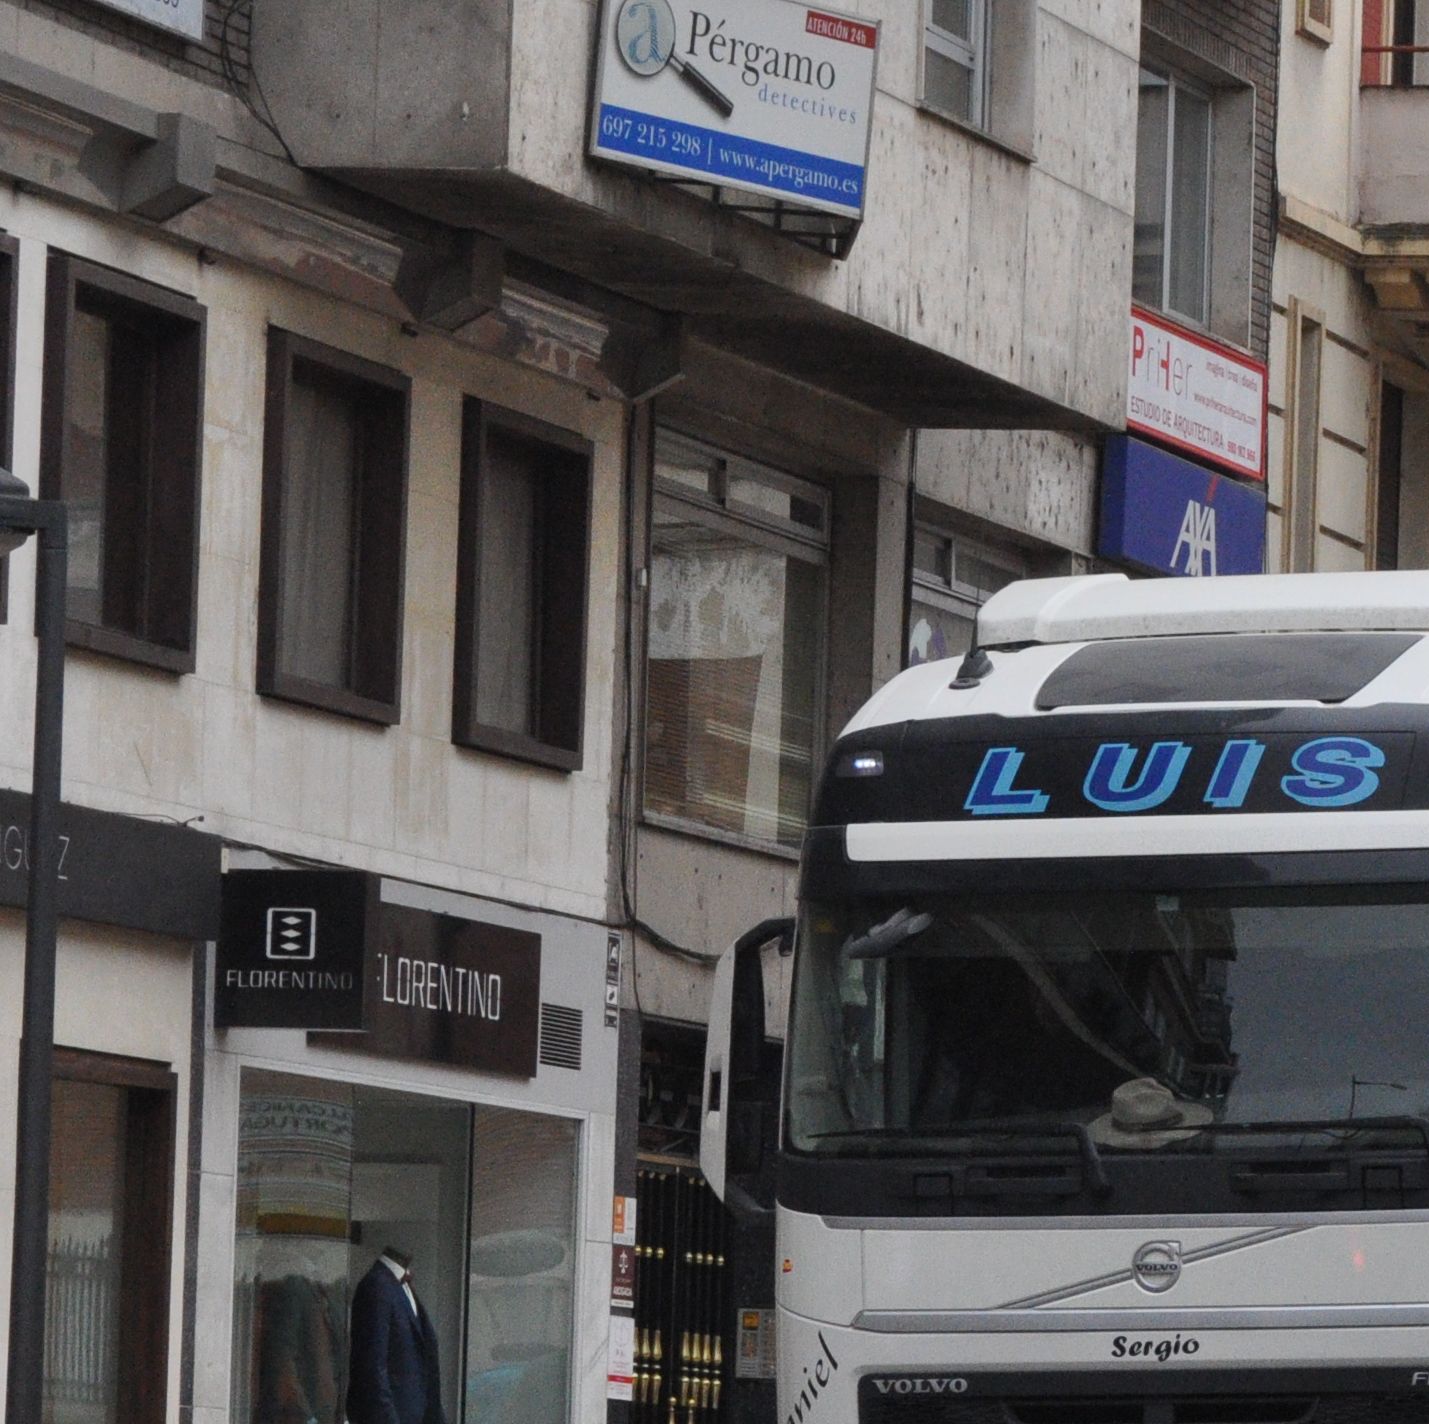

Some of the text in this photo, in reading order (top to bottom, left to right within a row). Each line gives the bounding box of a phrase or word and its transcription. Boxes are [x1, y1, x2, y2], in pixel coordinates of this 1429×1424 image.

[685, 10, 836, 90] Pérgamo
[807, 16, 866, 45] ATENCIÓN 24h
[758, 84, 856, 124] detectives
[602, 115, 858, 195] 697 215 298 www.apergamo.es
[1131, 395, 1160, 422] ESTUDIO
[1162, 408, 1172, 427] DE
[1173, 414, 1224, 449] ARQUITECTURA
[1169, 499, 1217, 576] AXA
[963, 736, 1386, 815] LUIS
[226, 970, 353, 991] FLORENTINO
[377, 953, 500, 1021] LORENTINO
[1136, 1263, 1178, 1272] VOLVO
[1111, 1333, 1199, 1362] Sergio
[872, 1378, 968, 1394] VOLVO
